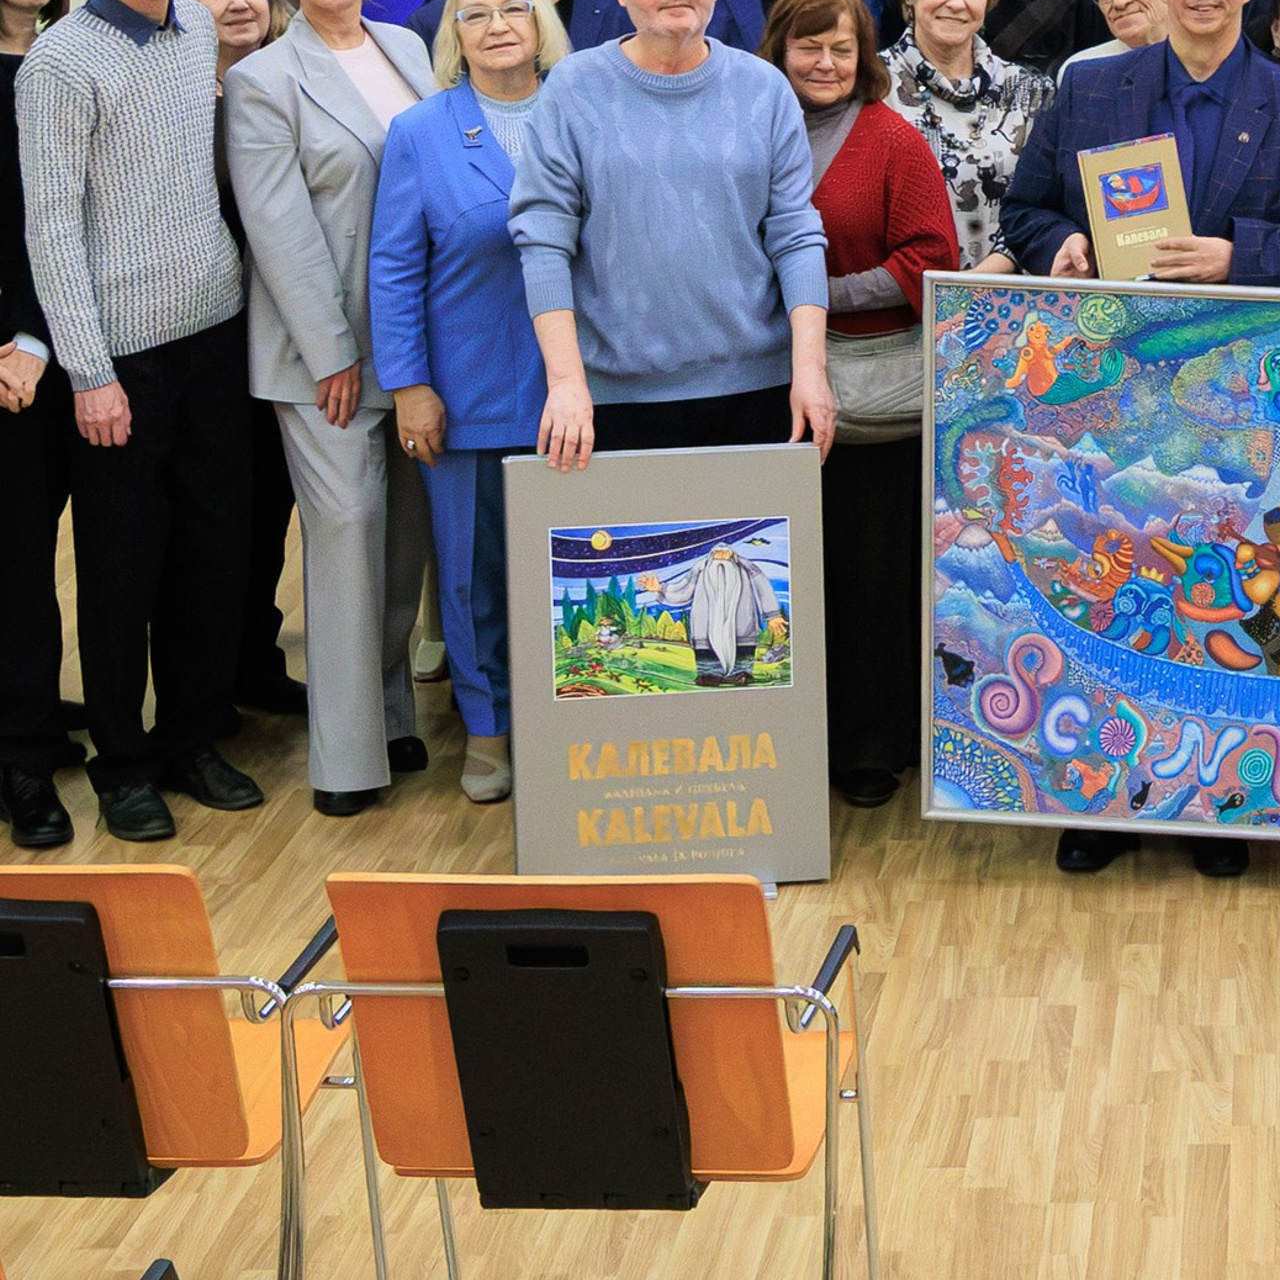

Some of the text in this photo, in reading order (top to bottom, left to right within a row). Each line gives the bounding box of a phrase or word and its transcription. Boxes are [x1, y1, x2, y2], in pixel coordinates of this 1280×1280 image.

[1116, 227, 1168, 247] Калевала
[568, 732, 778, 781] КАЛЕВАЛА
[577, 797, 774, 847] KALEVALA
